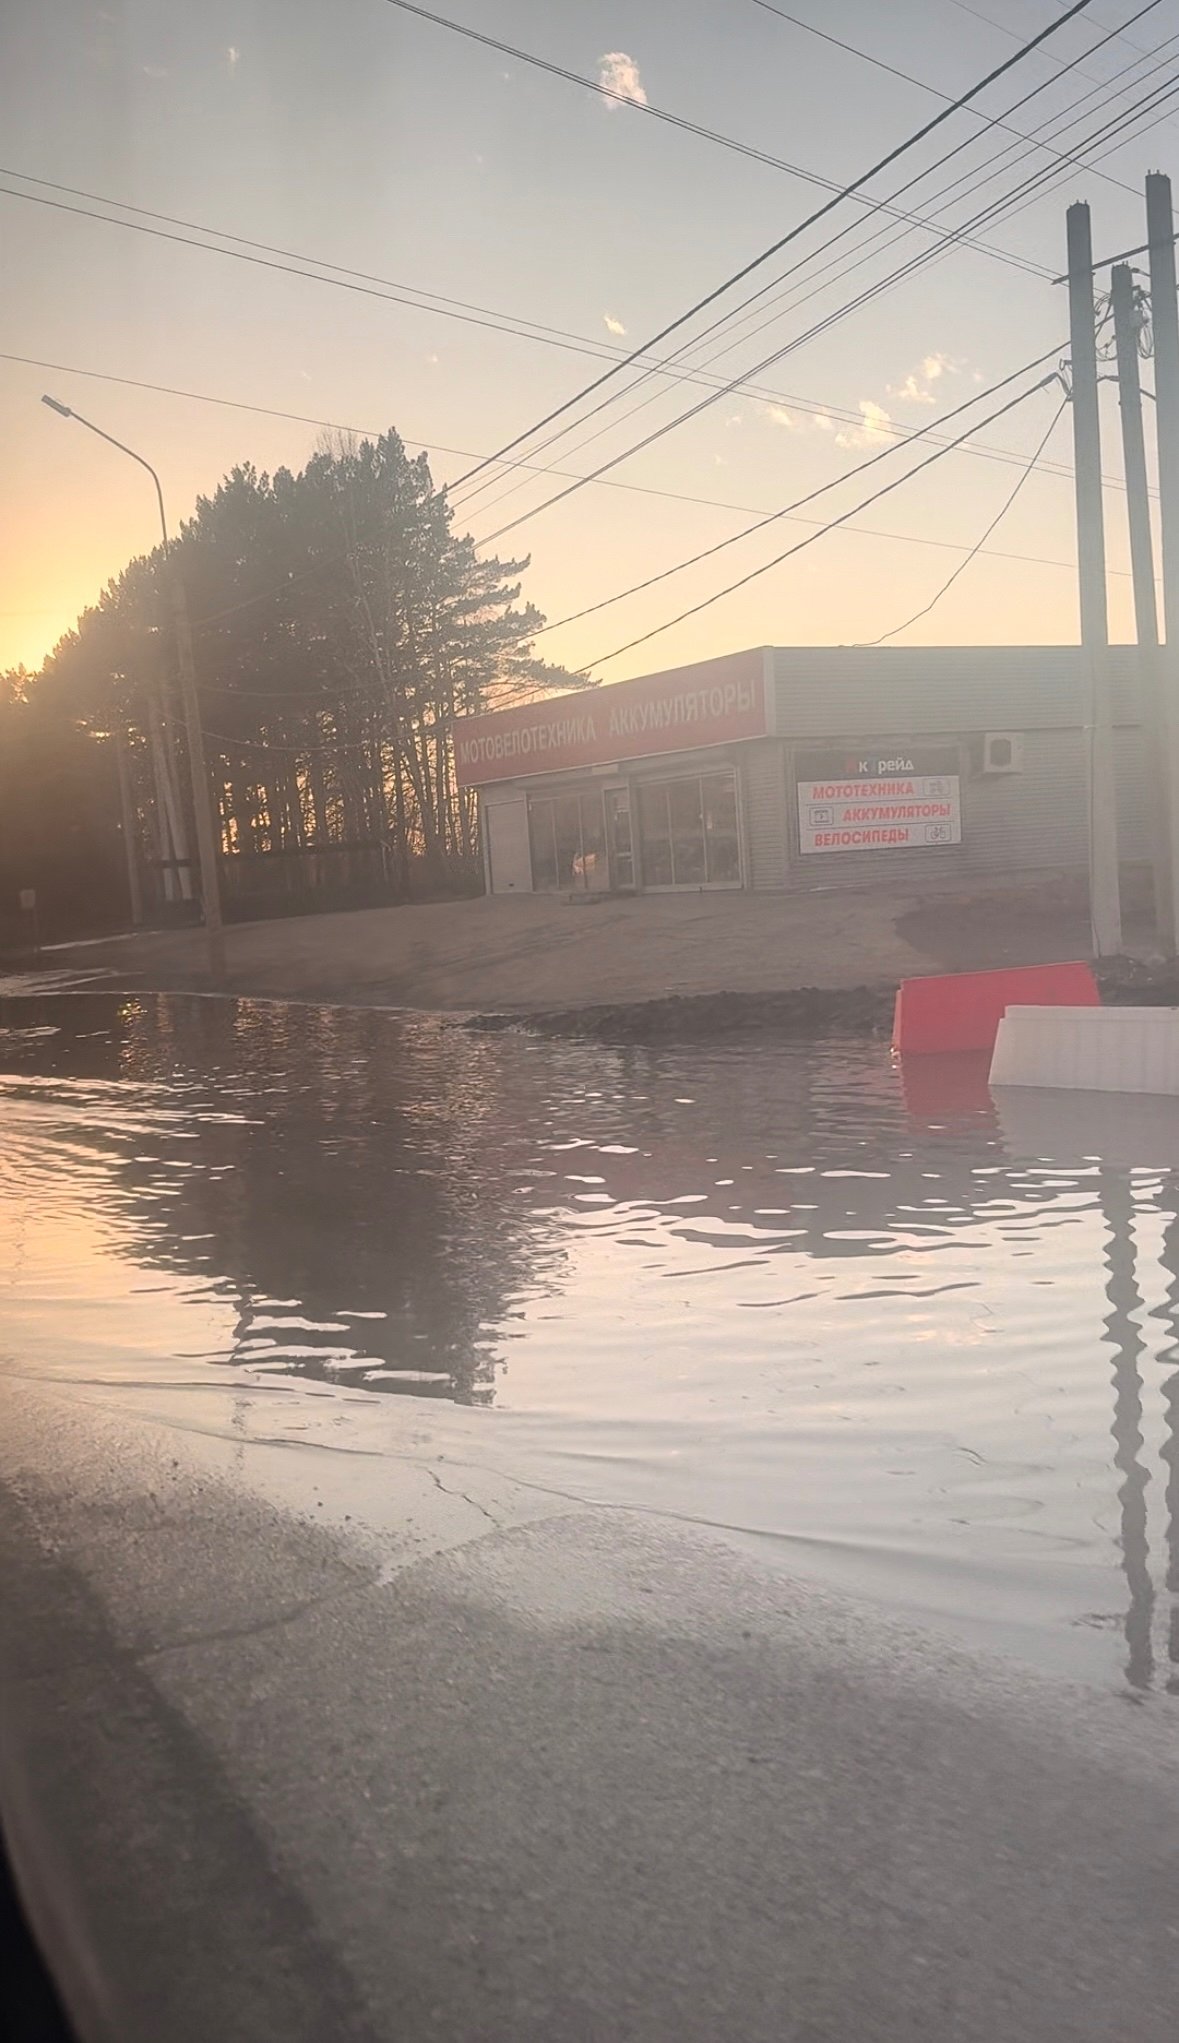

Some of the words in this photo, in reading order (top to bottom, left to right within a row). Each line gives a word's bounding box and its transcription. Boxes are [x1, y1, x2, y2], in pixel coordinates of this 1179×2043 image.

[460, 717, 597, 764] МОТОВЕЛОТЕХНИКА
[609, 680, 756, 736] АККУМУЛЯТОРЫ
[846, 757, 914, 776] крейд
[812, 782, 915, 800] МОТОТЕХНИКА
[844, 804, 951, 822] АККУМУЛЯТОРЫ
[815, 829, 909, 848] ВЕЛОСИПЕДЫ
